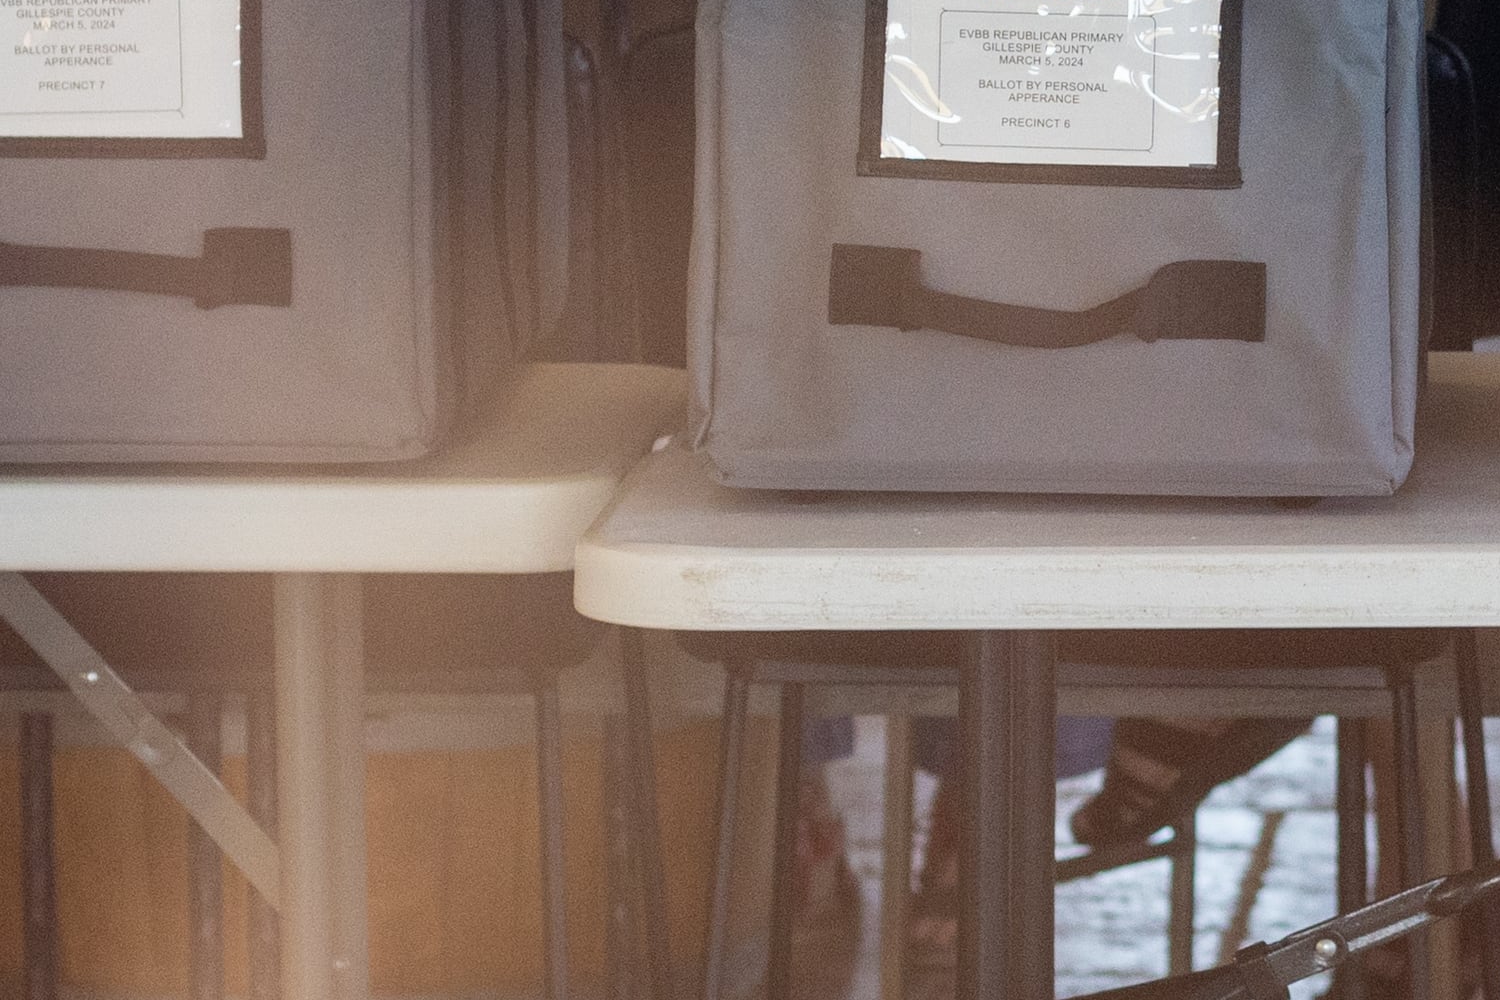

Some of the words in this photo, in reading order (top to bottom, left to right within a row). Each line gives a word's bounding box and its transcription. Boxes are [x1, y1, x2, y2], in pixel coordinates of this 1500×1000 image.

[16, 8, 74, 18] GILLESPIE
[77, 7, 125, 17] COUNTY
[33, 20, 74, 30] MARCH
[90, 19, 115, 29] 2024
[959, 29, 990, 40] EVBB
[993, 30, 1067, 41] REPUBLICAN
[1070, 32, 1123, 43] PRIMARY
[14, 45, 58, 55] BALLOT
[61, 44, 76, 54] BY
[79, 43, 139, 54] PERSONAL
[982, 42, 1041, 53] GILLESPIE
[1045, 43, 1094, 54] OUNTY
[44, 56, 113, 66] APPERANCE
[999, 55, 1041, 66] MARCH
[1045, 57, 1055, 67] 5,
[1058, 56, 1084, 67] 2024
[38, 80, 95, 91] PRECINCT
[99, 80, 105, 89] 7
[978, 79, 1022, 90] BALLOT
[1026, 80, 1041, 90] BY
[1045, 81, 1108, 92] PERSONAL
[1008, 93, 1080, 104] APPERANCE
[1001, 117, 1060, 129] PRECINCT
[1063, 119, 1071, 129] 6
